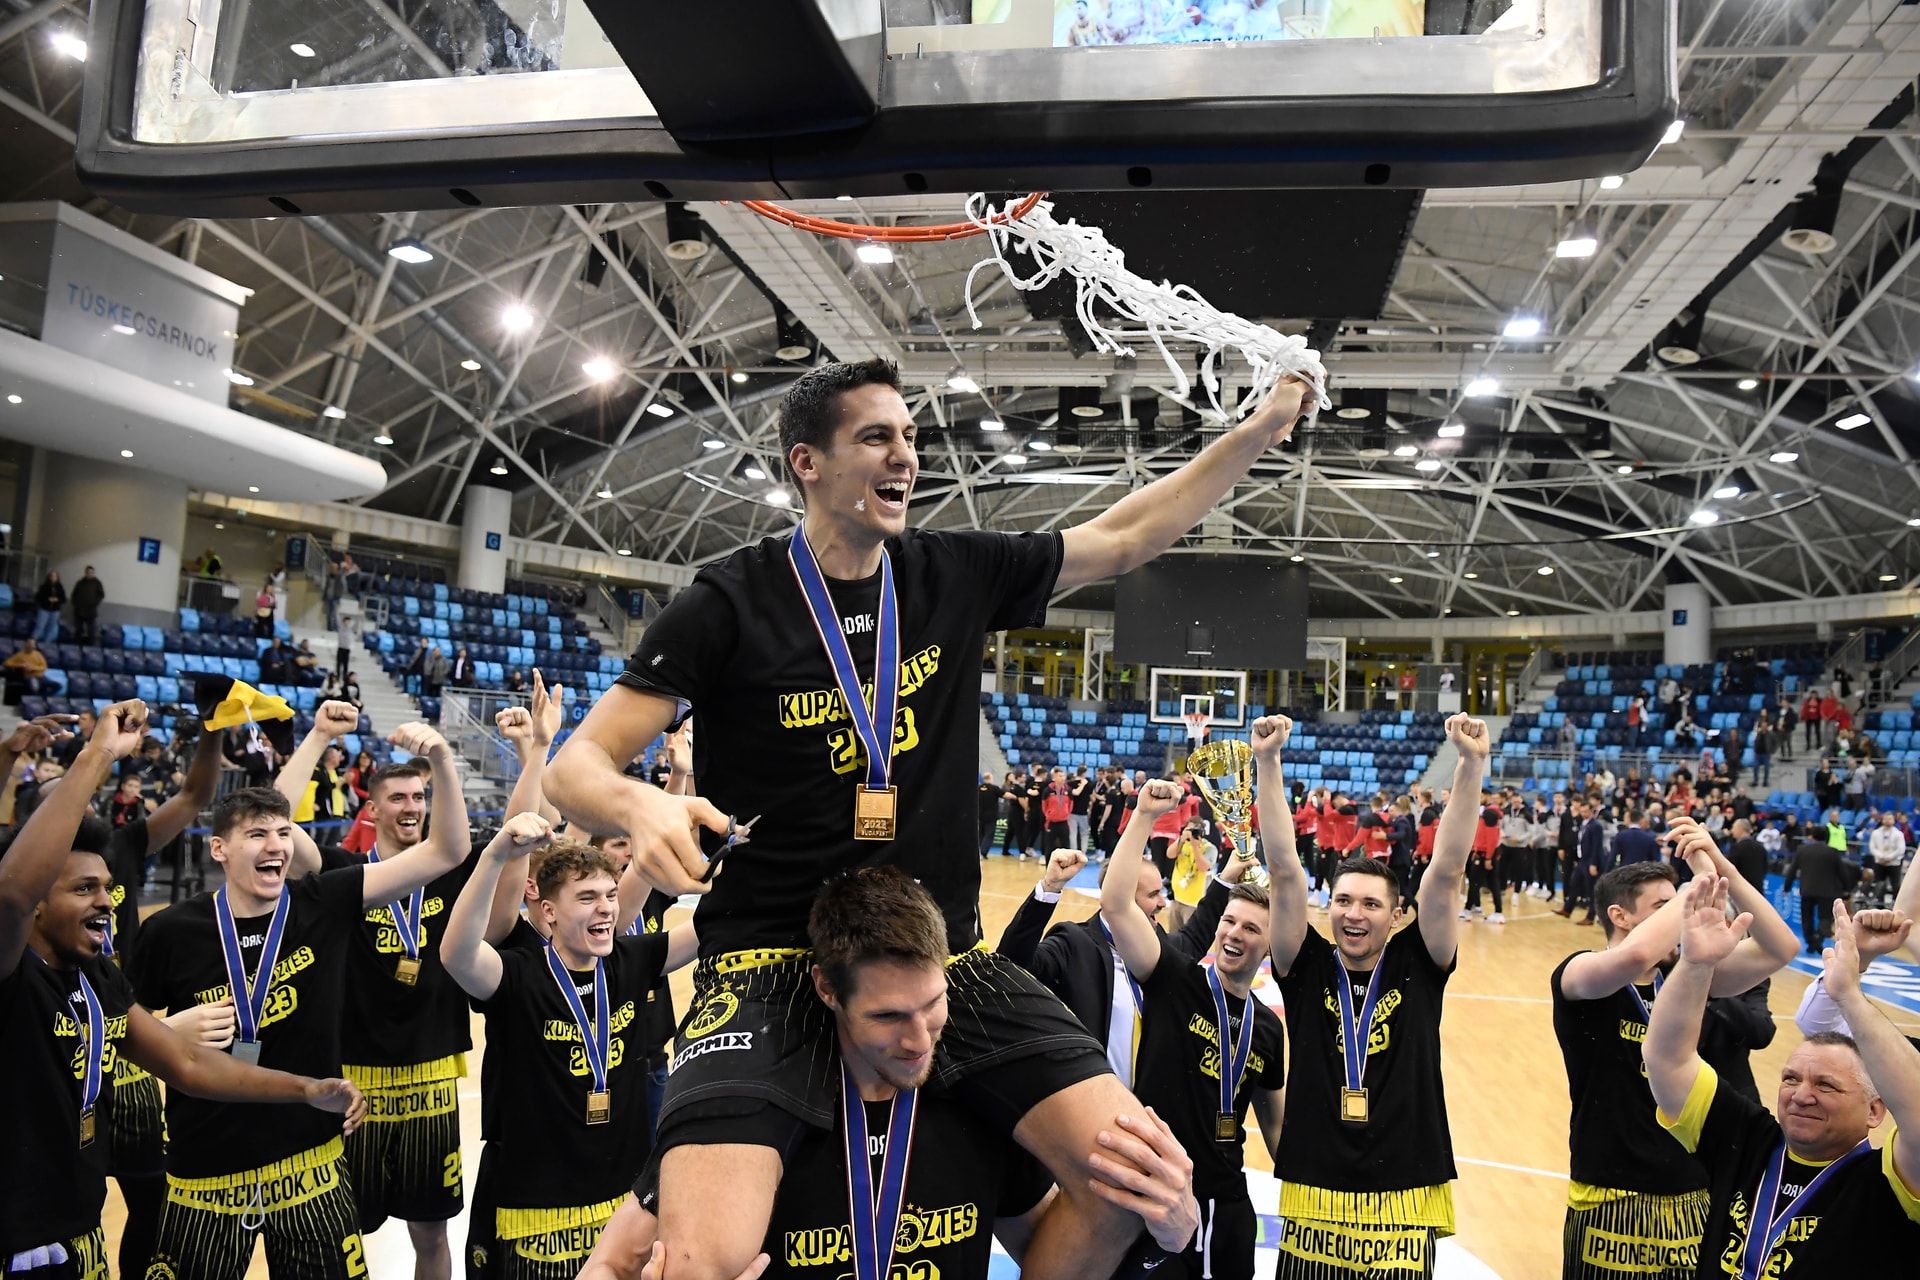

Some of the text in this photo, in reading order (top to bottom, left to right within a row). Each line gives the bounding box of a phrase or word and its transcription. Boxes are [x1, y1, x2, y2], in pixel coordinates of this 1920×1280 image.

[143, 541, 157, 560] F
[779, 645, 941, 728] KUPAZTES
[827, 706, 919, 775] 23
[785, 1203, 978, 1267] KUPAZTES
